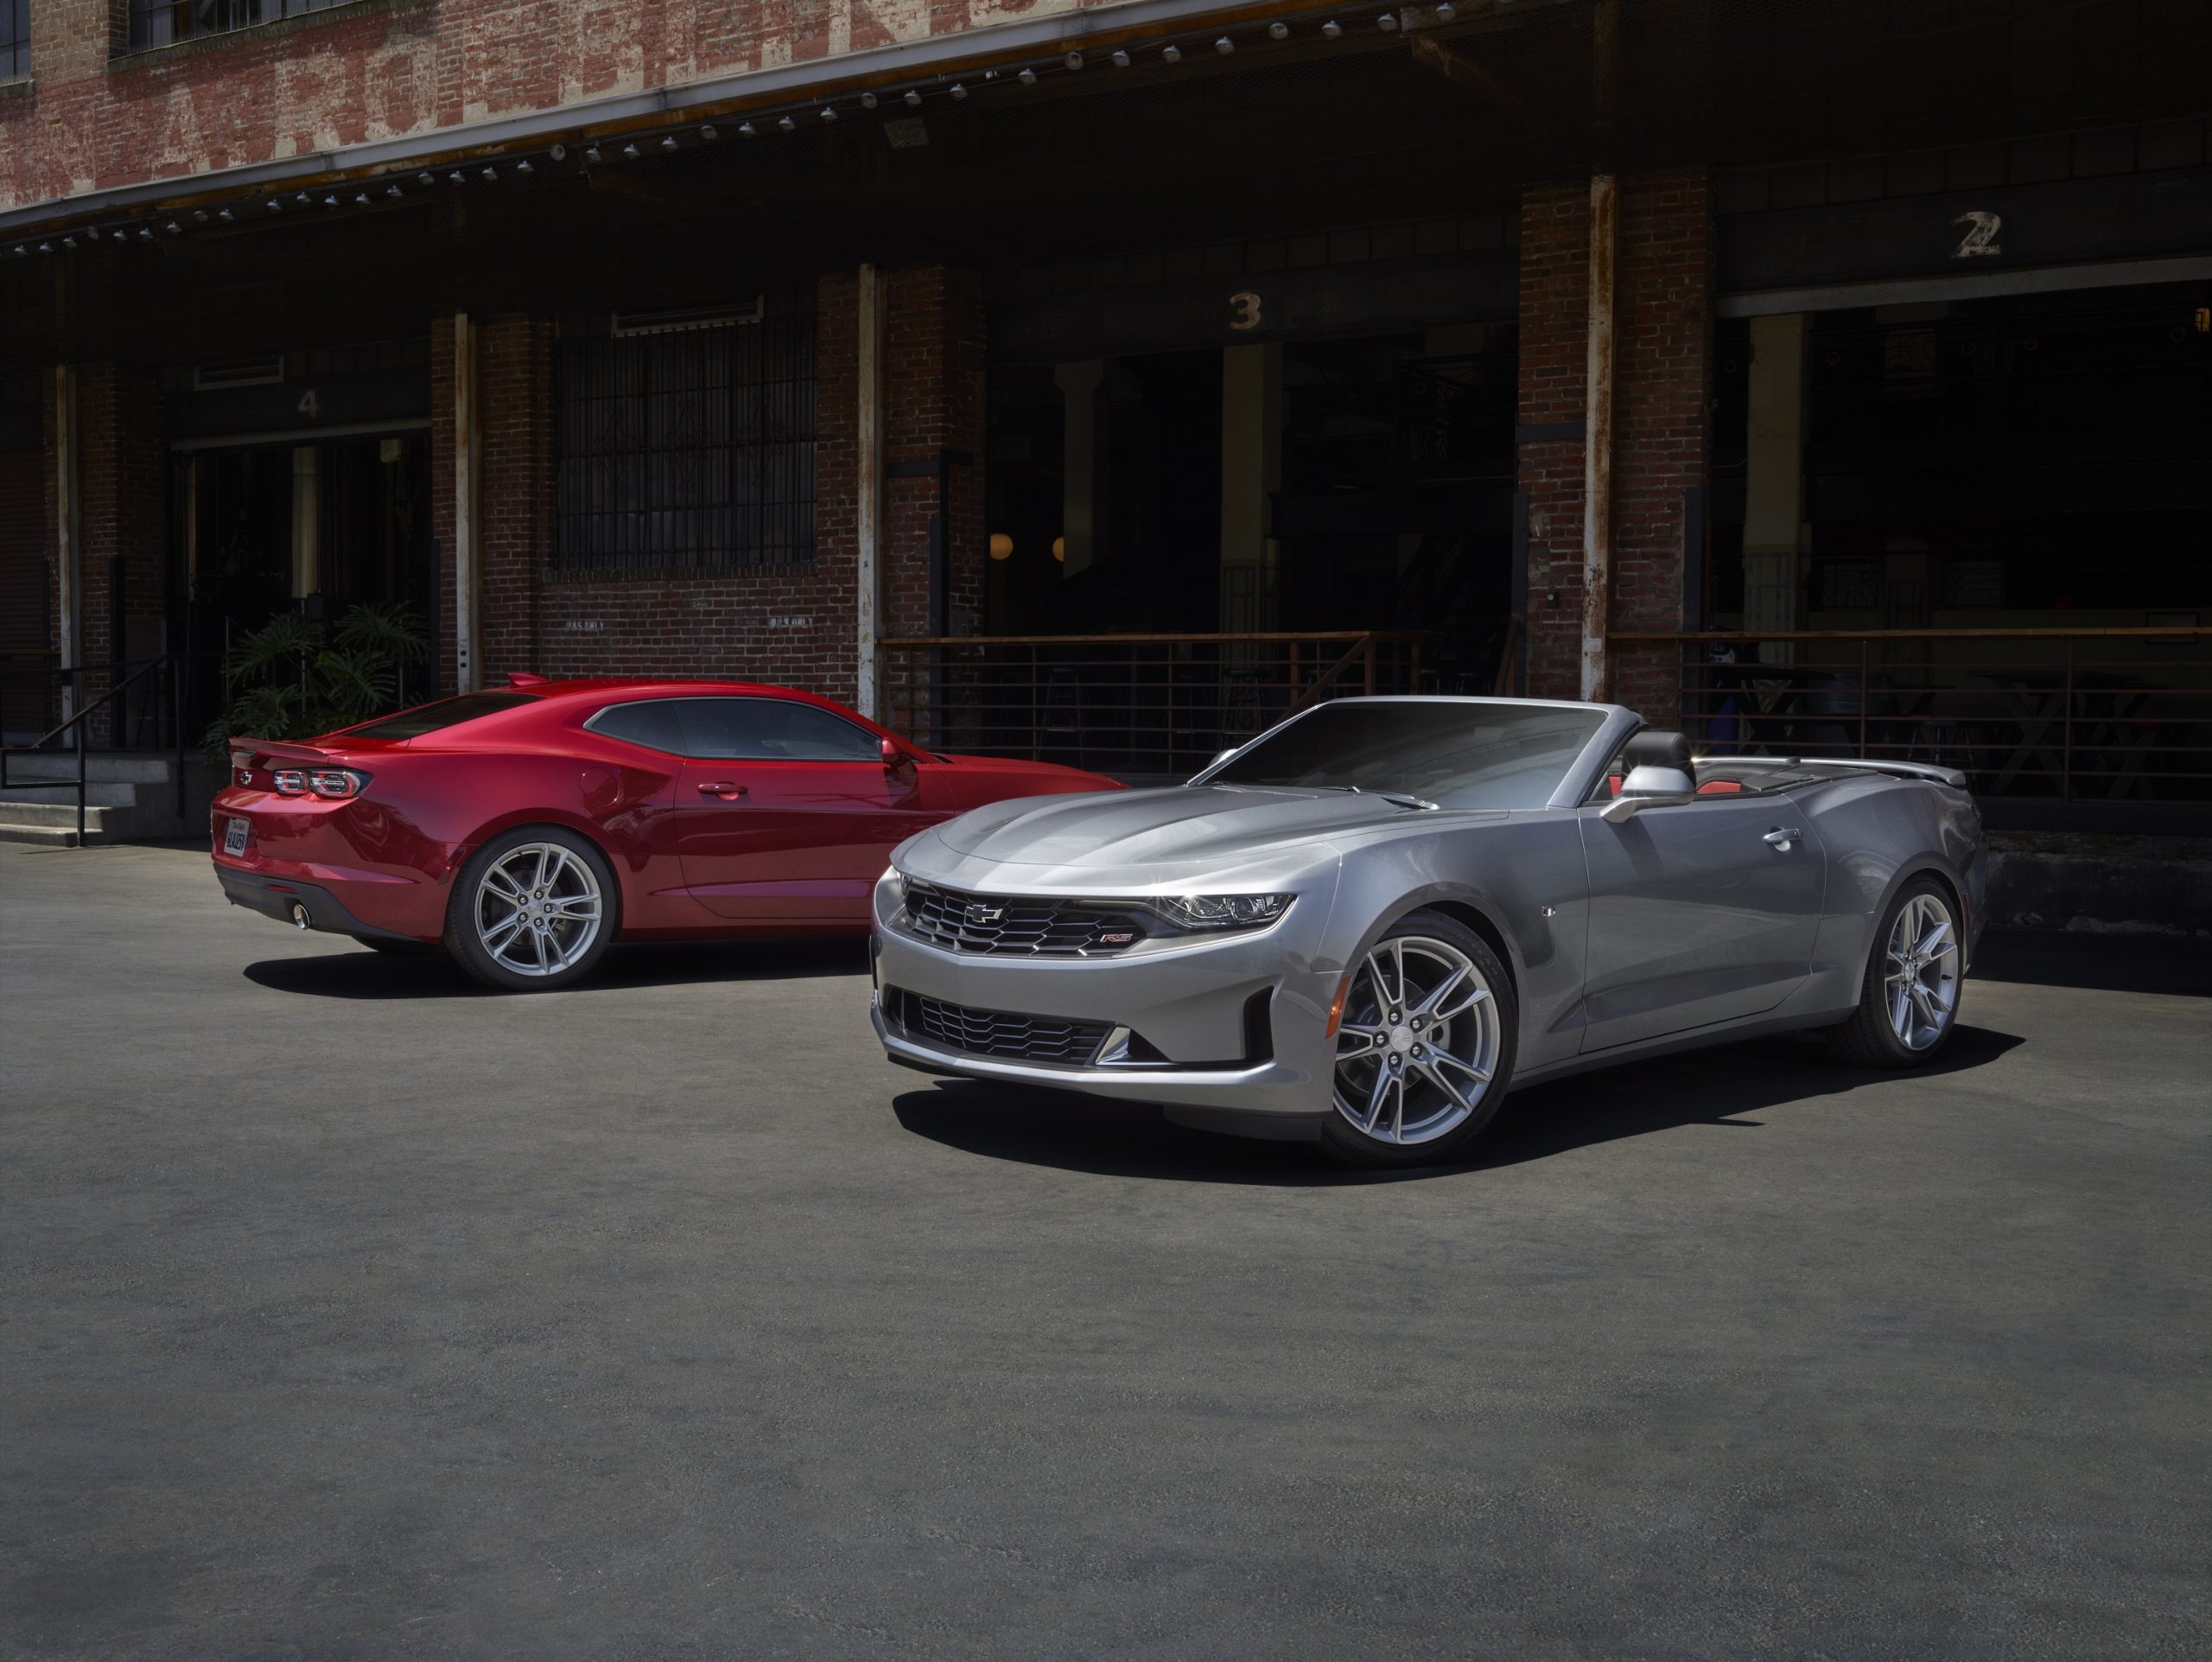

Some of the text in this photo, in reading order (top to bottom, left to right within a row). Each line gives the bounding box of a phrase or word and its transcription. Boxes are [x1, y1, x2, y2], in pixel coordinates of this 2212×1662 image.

[1951, 211, 2001, 258] 2
[1230, 292, 1262, 330] 3
[298, 390, 319, 417] 4
[1099, 933, 1134, 943] RS
